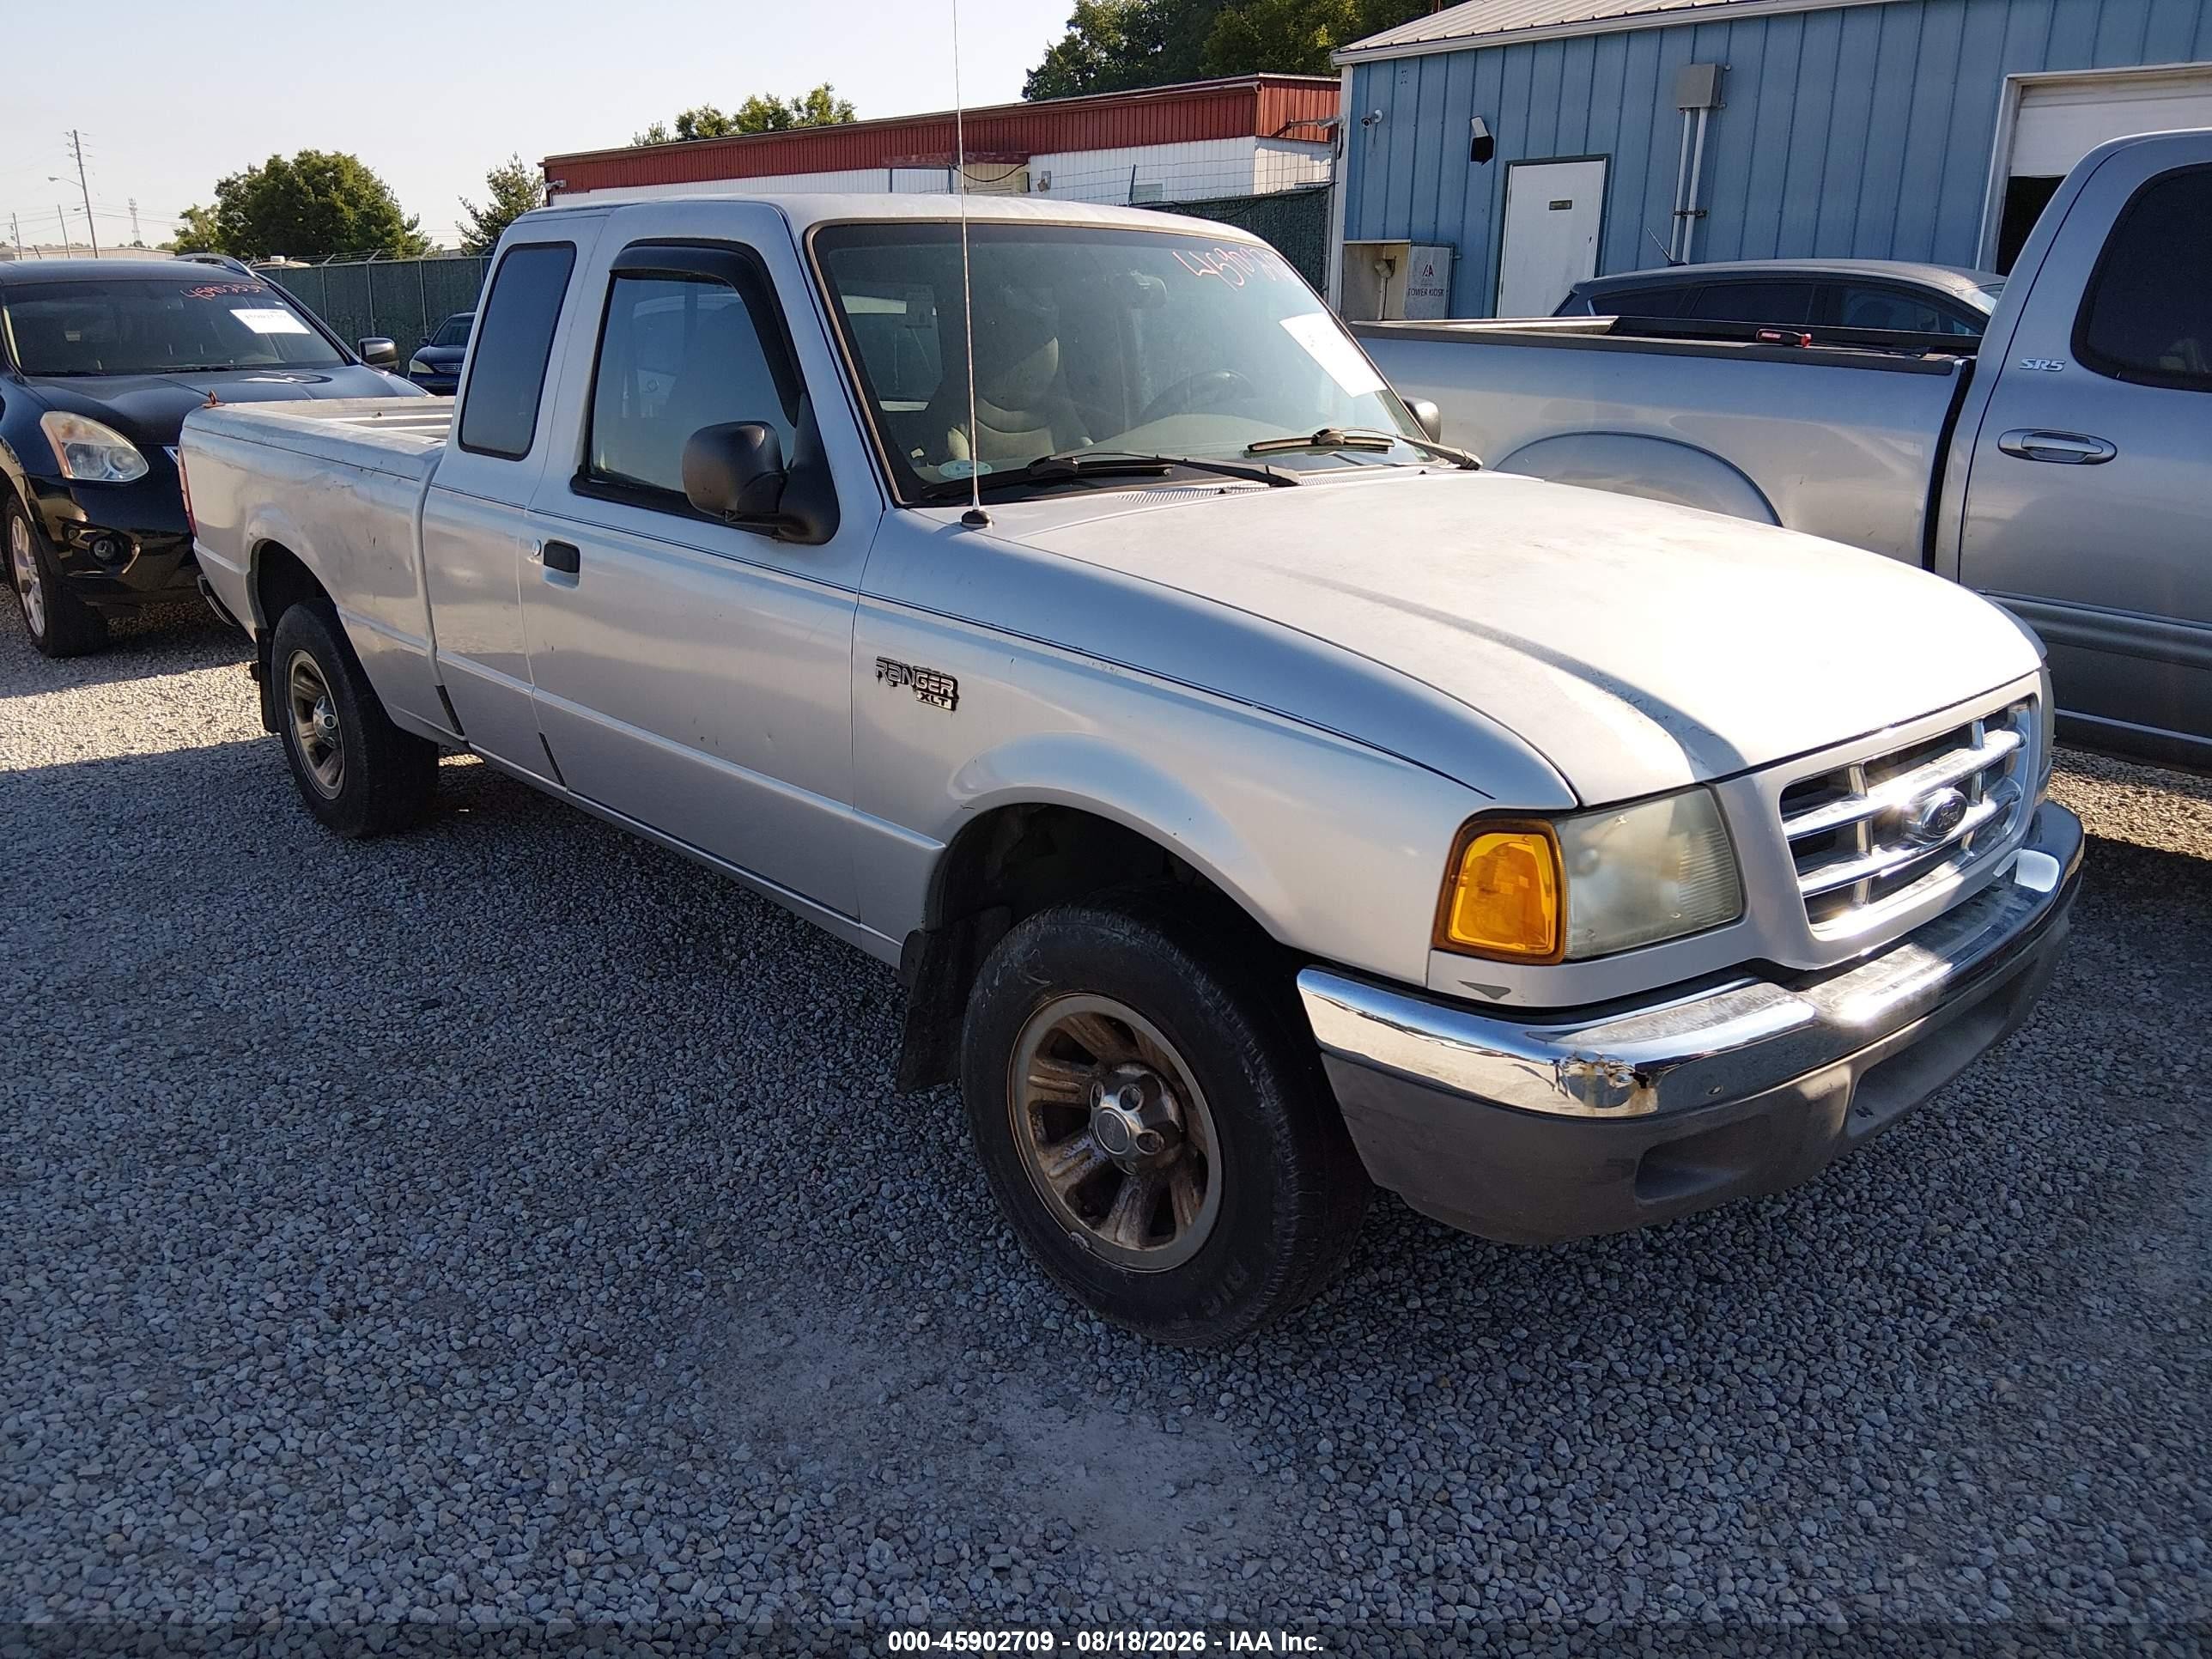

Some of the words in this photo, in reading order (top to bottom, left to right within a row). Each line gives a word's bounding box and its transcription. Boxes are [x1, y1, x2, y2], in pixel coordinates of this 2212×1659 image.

[1407, 288, 1428, 296] TOWER
[2019, 358, 2066, 372] SR5
[875, 657, 956, 698] RANGER
[919, 690, 949, 707] XLT
